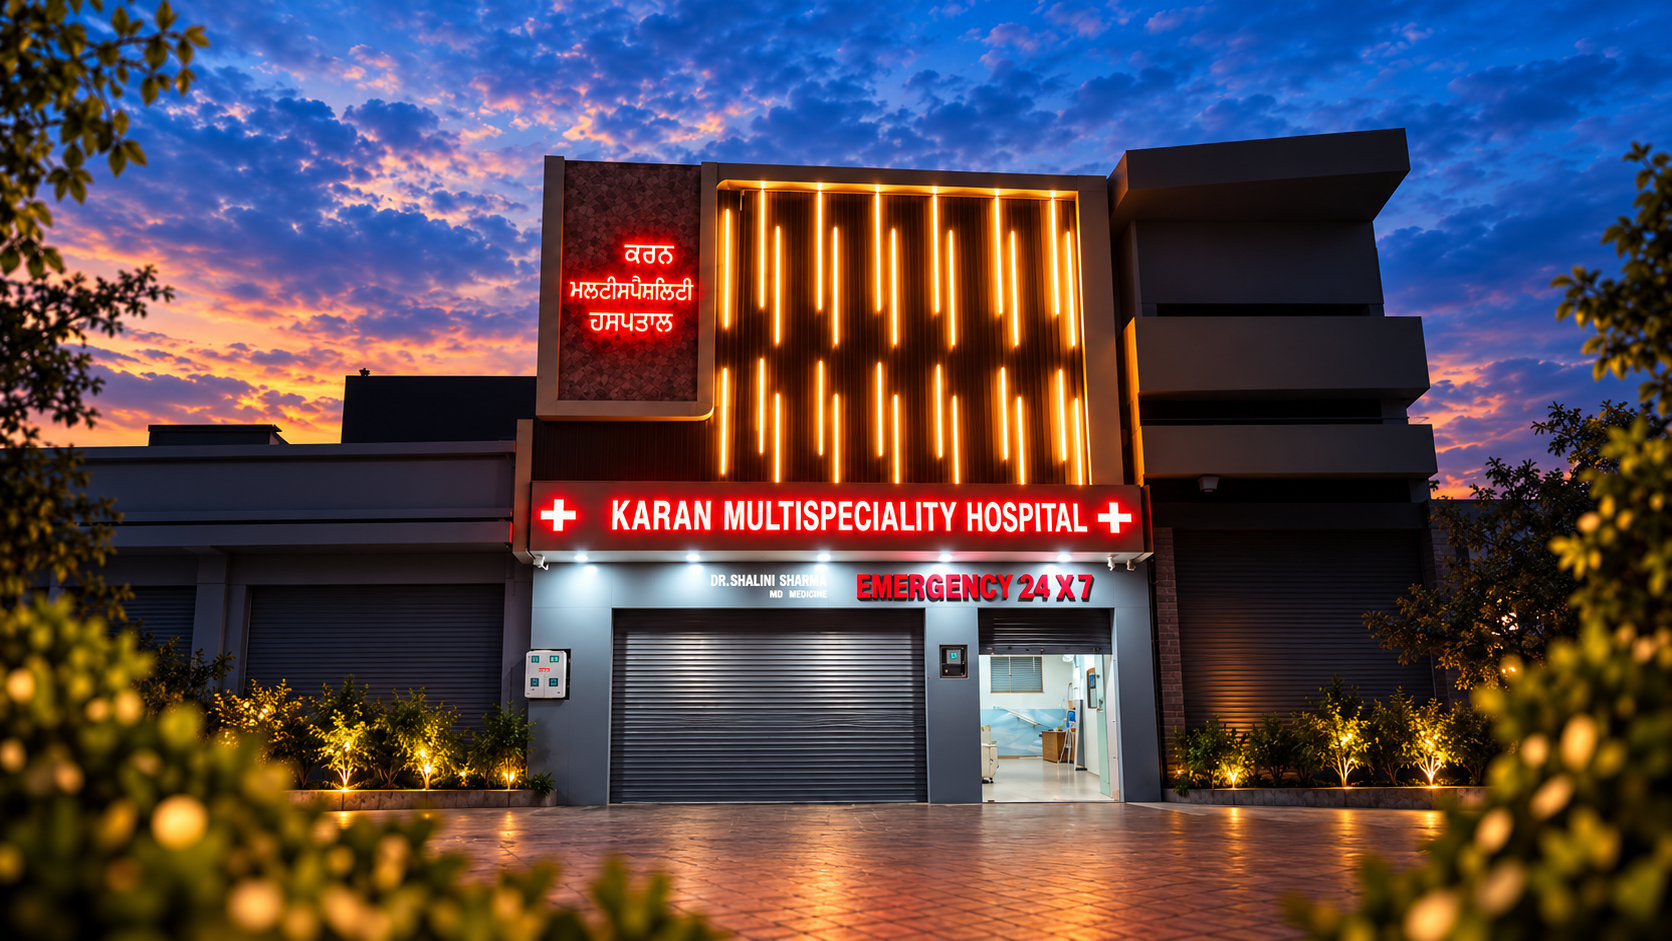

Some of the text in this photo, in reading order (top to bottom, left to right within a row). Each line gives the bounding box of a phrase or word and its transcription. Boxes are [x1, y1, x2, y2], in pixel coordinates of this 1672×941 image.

[624, 244, 675, 265] ਕਰਨ
[570, 275, 694, 301] ਮਲਟੀਸਪੈਸ਼ਲਿਟੀ
[589, 312, 674, 332] ਹਸਪਤਾਲ
[611, 499, 1088, 533] KARAN MULTISPECIALITY HOSPITAL
[710, 574, 827, 587] DR.SHALINI SHARMA
[856, 573, 1094, 601] EMERGENCY 24 X 7
[769, 590, 828, 599] MD MEDICINE
